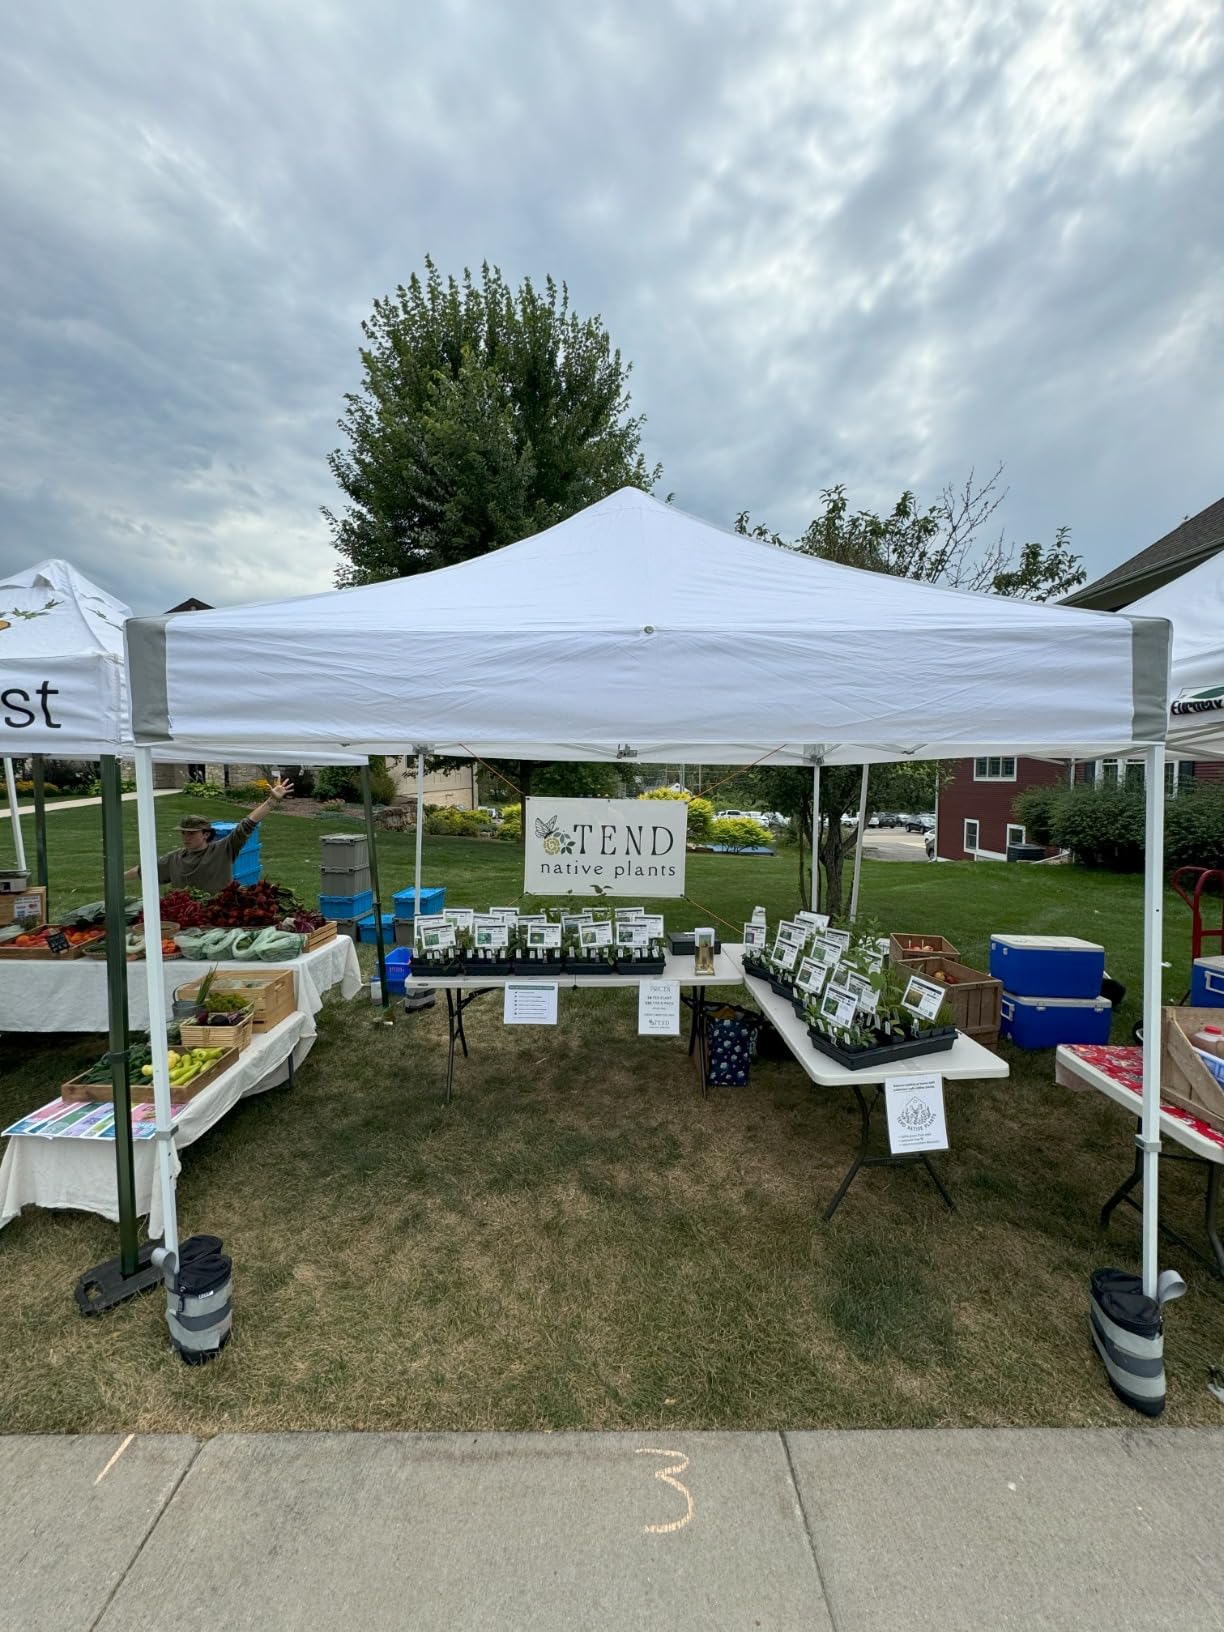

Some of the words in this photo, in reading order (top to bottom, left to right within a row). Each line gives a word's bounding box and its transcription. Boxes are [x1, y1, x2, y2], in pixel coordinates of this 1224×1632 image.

[573, 824, 674, 856] TEND
[540, 860, 604, 875] native
[614, 860, 676, 879] plants
[635, 1447, 696, 1534] 3
